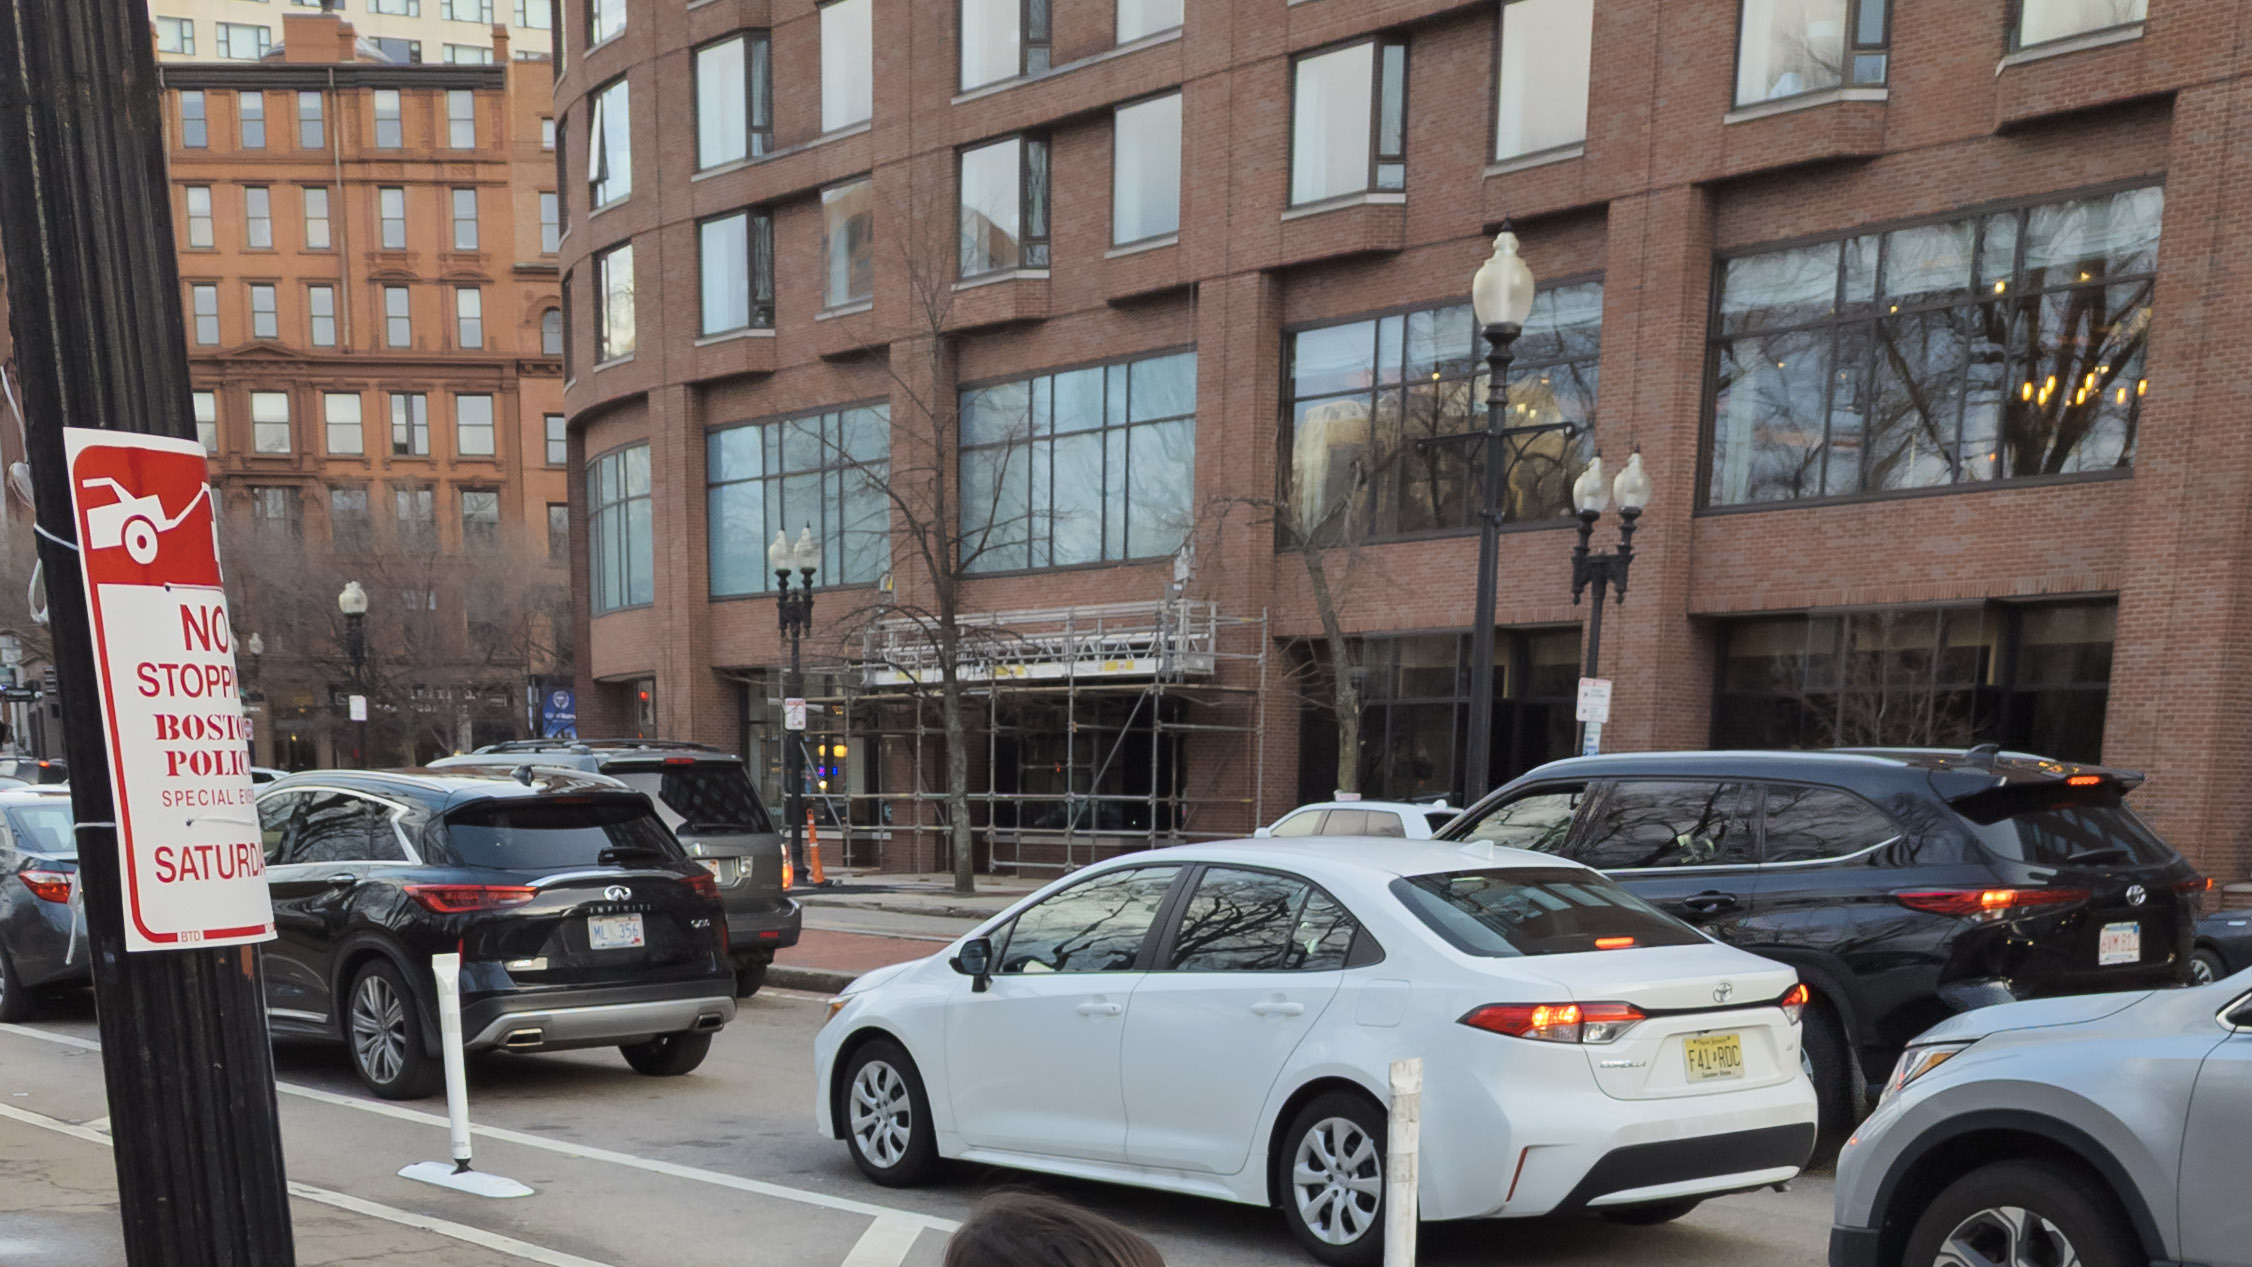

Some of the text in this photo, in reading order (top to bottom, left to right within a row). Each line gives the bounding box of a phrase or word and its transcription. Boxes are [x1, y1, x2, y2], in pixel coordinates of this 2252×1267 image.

[179, 604, 229, 654] NO
[136, 661, 240, 699] STOPPI
[152, 713, 245, 741] BOSTO
[164, 750, 251, 777] POLIC
[162, 788, 234, 807] SPECIAL
[154, 842, 266, 884] SATURDA
[181, 930, 201, 943] BTD
